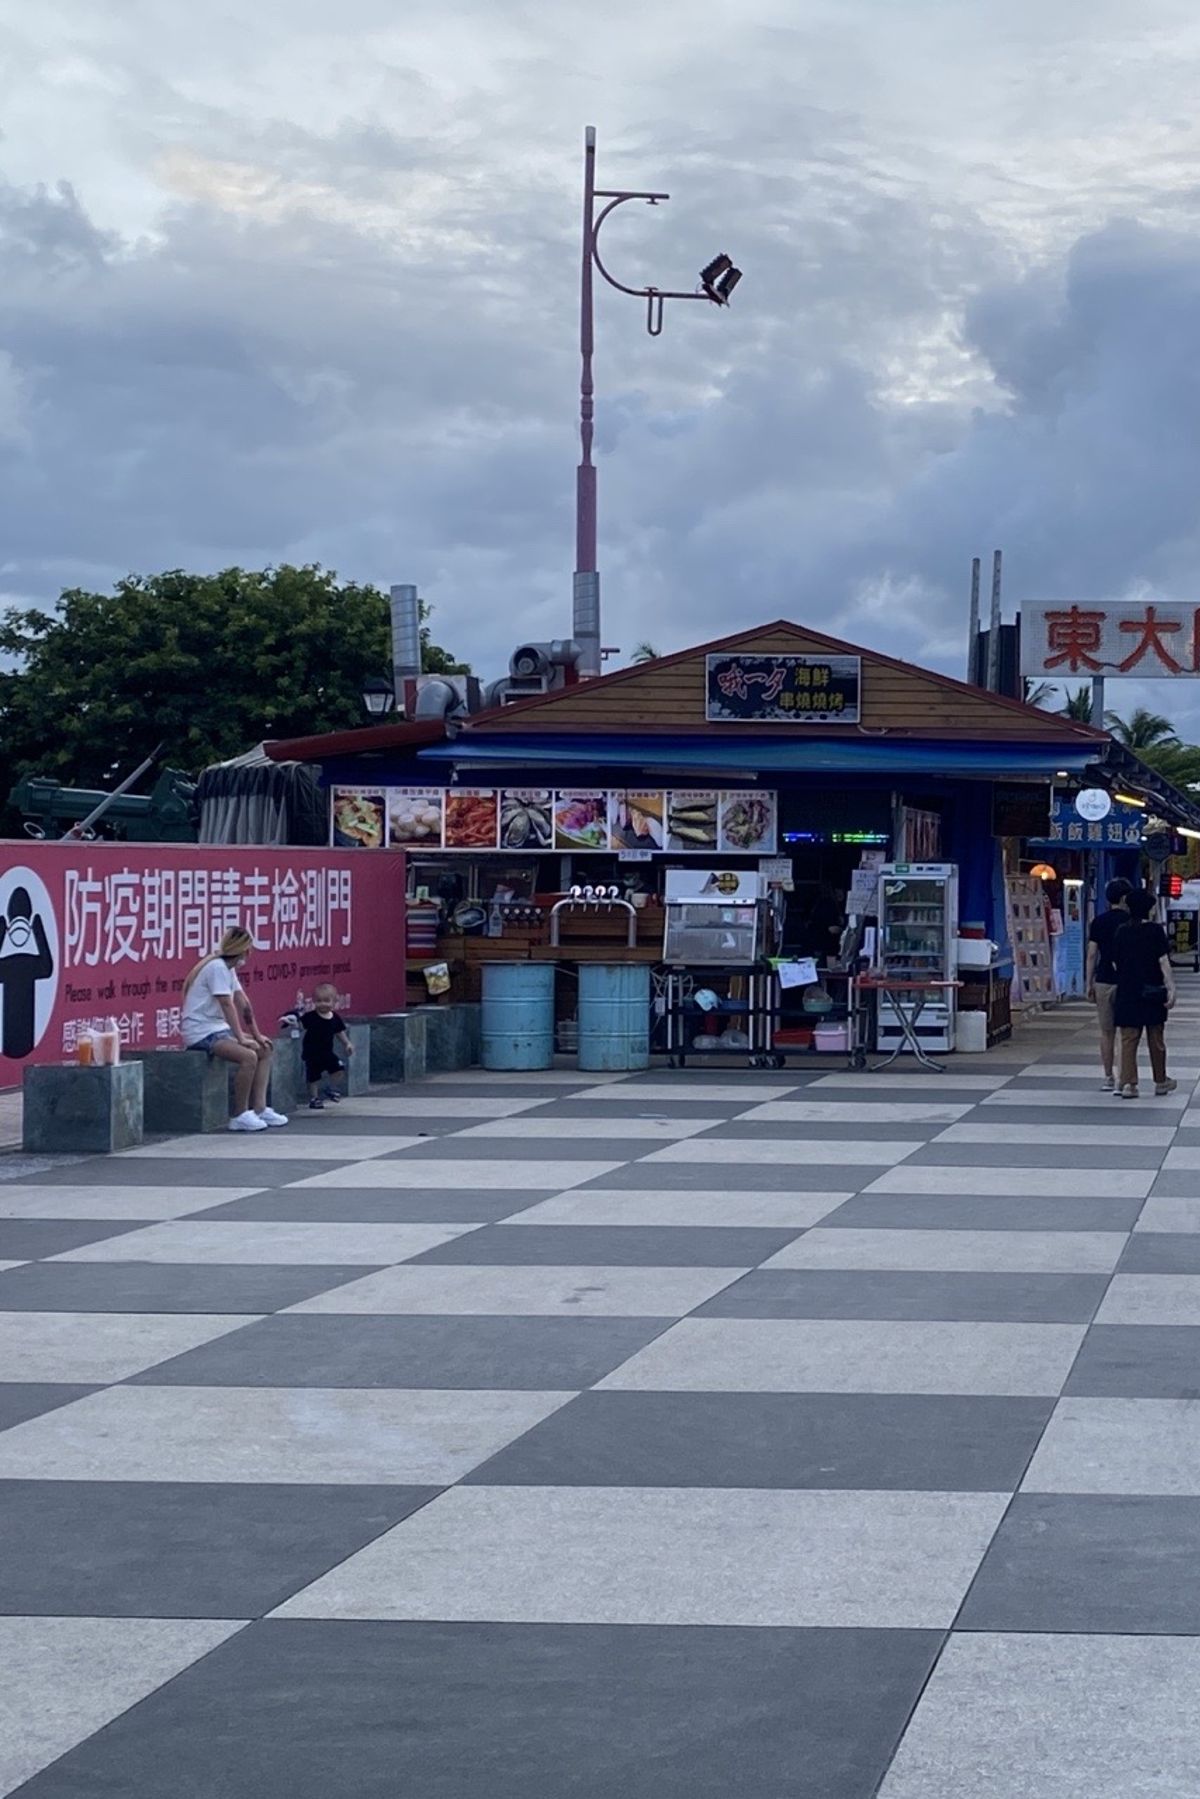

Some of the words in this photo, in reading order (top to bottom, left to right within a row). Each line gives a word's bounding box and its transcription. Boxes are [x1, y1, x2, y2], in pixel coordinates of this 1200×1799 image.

[794, 667, 830, 688] 海鮮
[64, 867, 352, 968] 防疫期間請走檢測門
